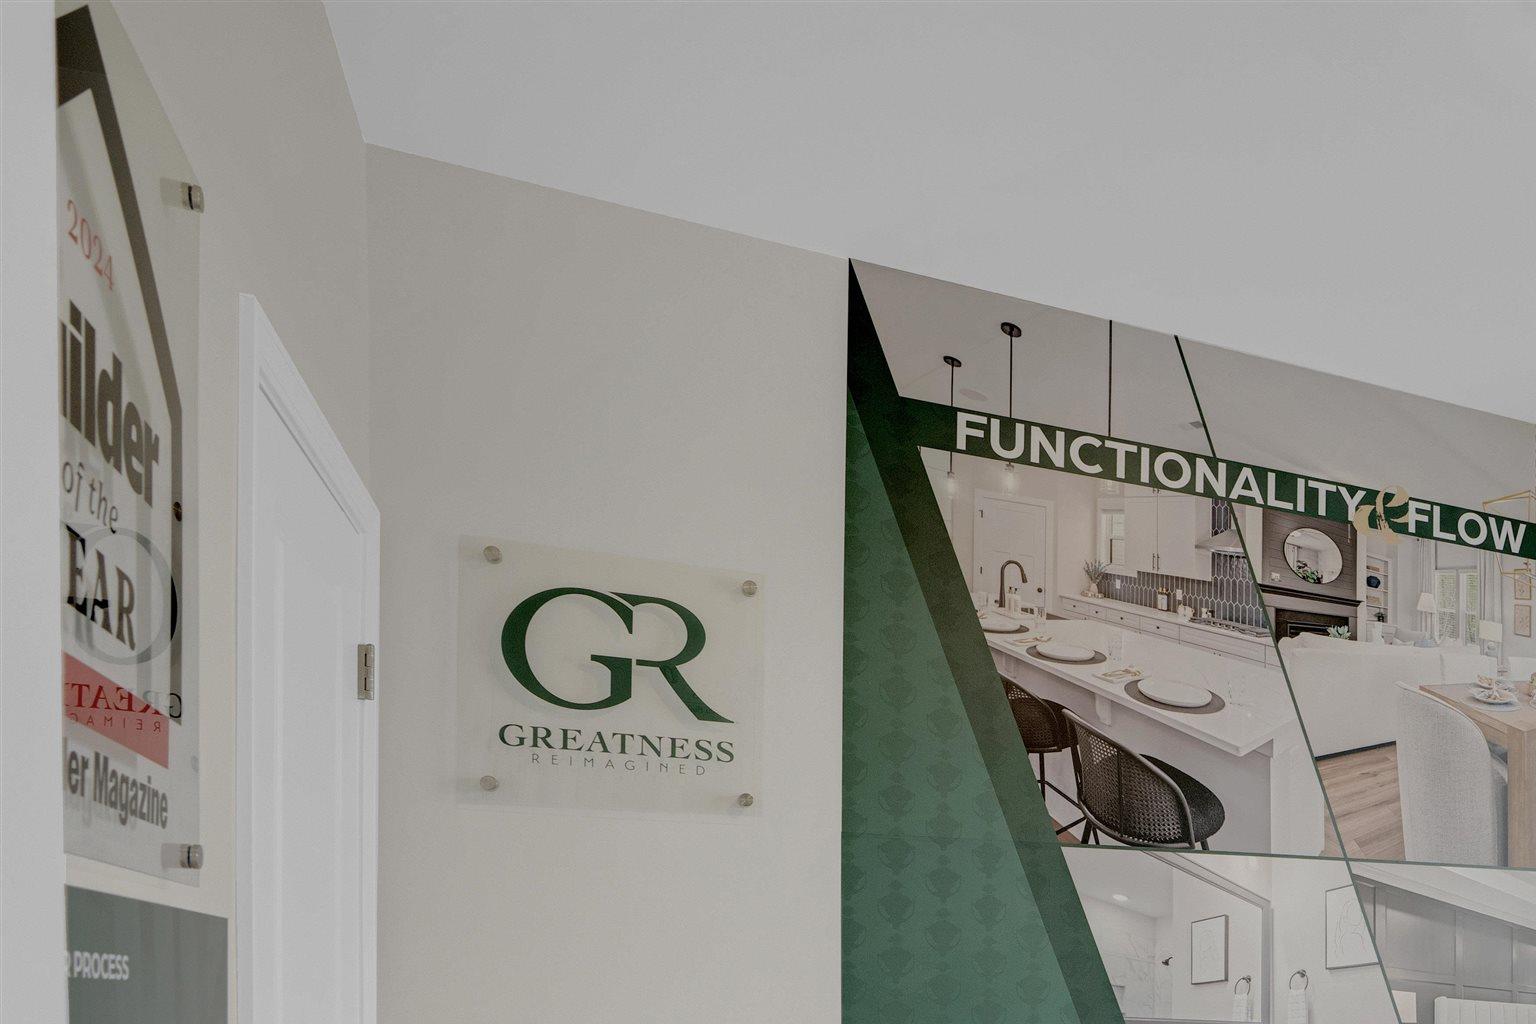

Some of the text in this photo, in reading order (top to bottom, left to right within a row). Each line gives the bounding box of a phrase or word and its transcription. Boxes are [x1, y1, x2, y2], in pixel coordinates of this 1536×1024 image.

[67, 199, 114, 291] 2024
[62, 461, 119, 535] of the
[956, 411, 1367, 522] FUNCTIONALITY
[1408, 500, 1527, 554] FLOW
[65, 523, 136, 652] EAR
[501, 587, 736, 724] GR
[498, 723, 735, 763] GREATNESS
[532, 752, 706, 776] REIMAGINED
[93, 751, 168, 830] Magazine
[73, 950, 130, 981] PROCESS
